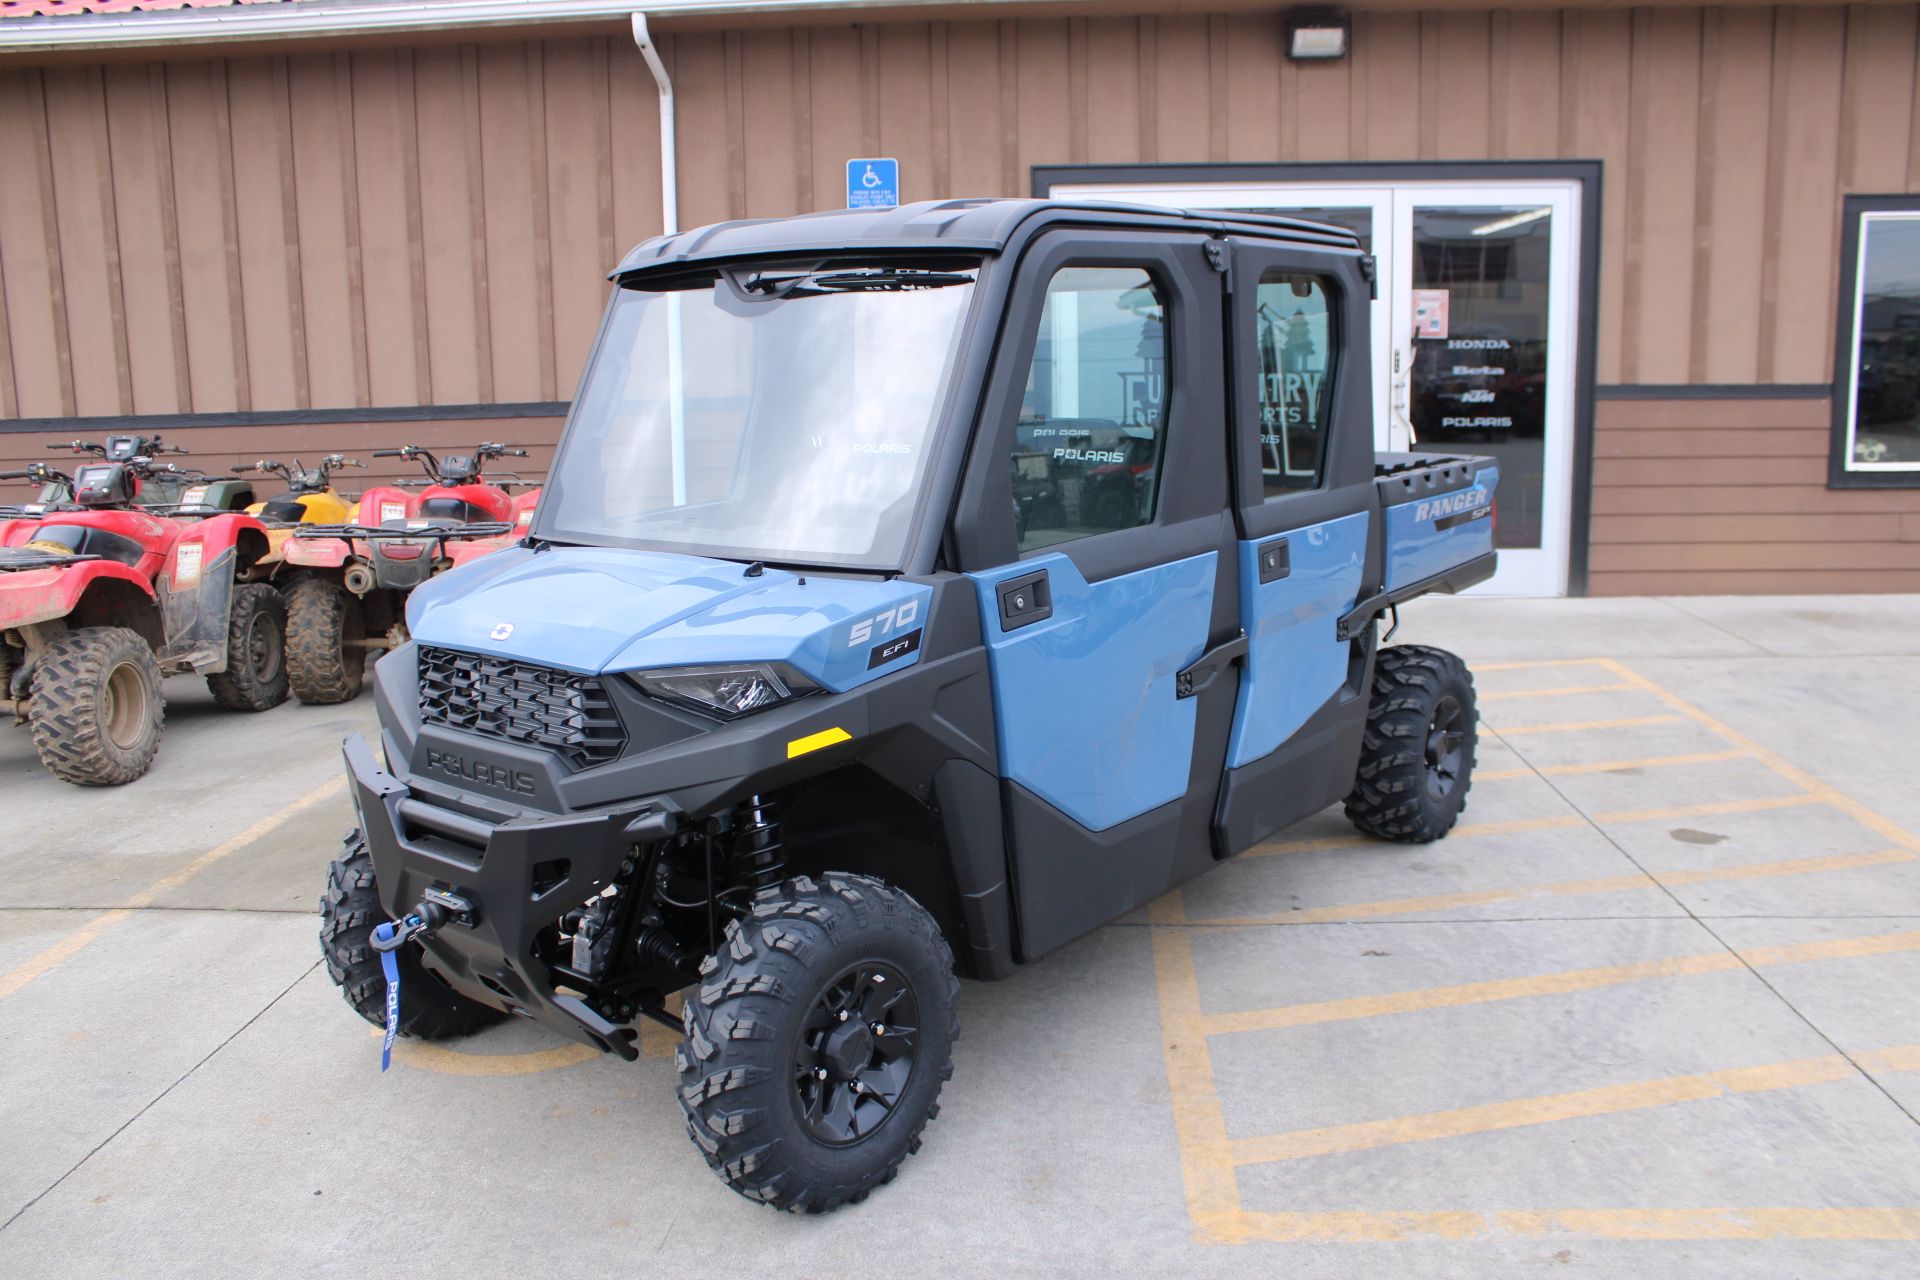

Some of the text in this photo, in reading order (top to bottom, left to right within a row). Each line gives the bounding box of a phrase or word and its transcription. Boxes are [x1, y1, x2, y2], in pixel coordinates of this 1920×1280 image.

[1448, 339, 1511, 349] HONDA
[1442, 416, 1513, 427] POLARIS
[854, 443, 911, 453] POLARIS
[1053, 448, 1124, 463] POLARIS
[1415, 488, 1487, 522] RANGER
[848, 600, 918, 648] 570
[883, 640, 909, 657] EFI
[427, 748, 536, 797] POLARIS
[385, 981, 398, 1051] POLARIS
